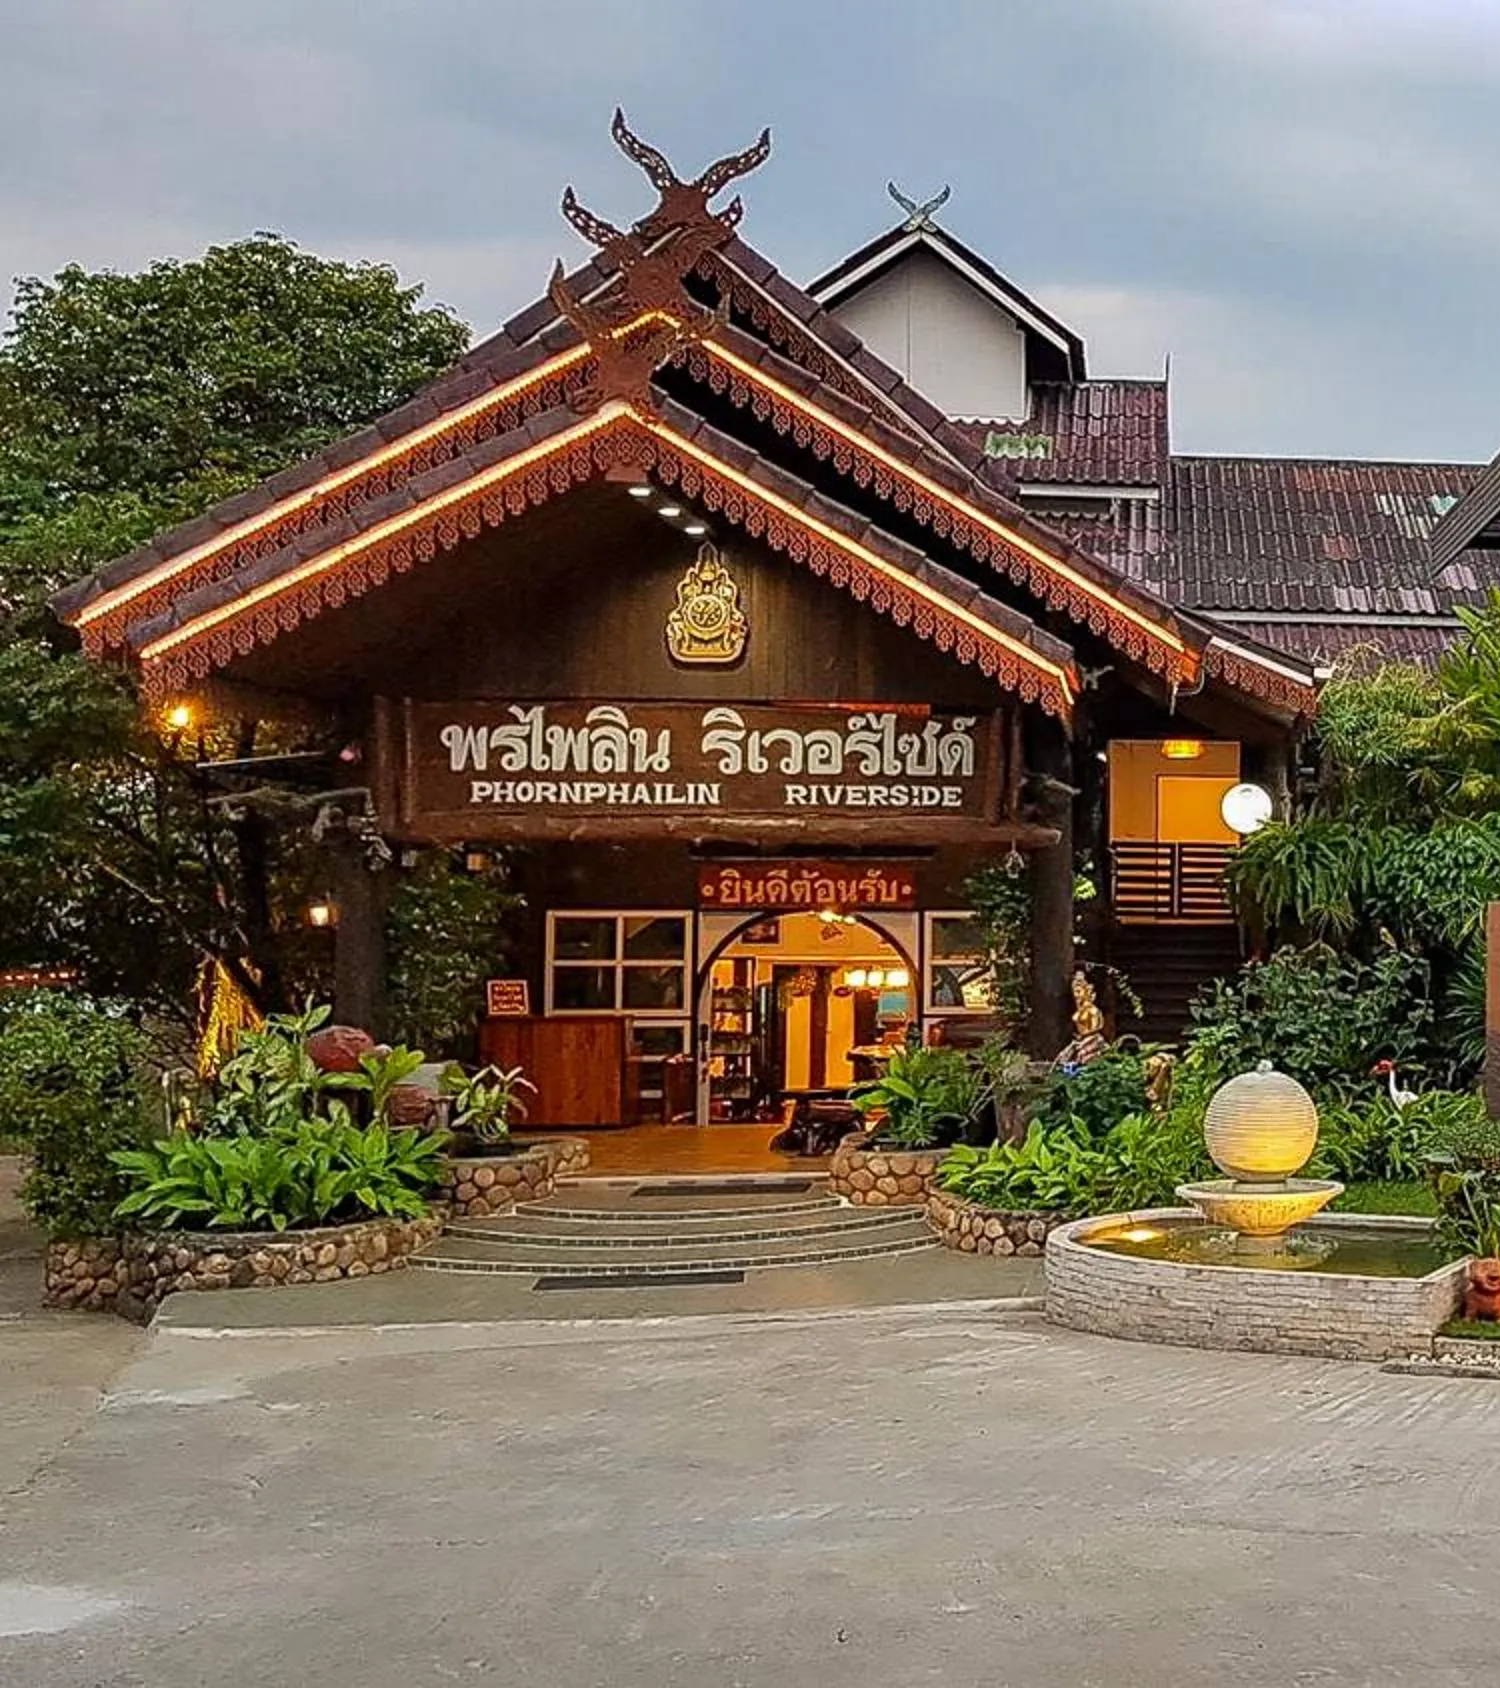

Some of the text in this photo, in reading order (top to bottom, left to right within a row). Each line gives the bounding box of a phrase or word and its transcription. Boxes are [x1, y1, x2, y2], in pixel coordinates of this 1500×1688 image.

[440, 705, 976, 777] พรไพลิน ริเวอร์ไซด์
[469, 781, 963, 807] PHORNPHAILIN RIVERSIDE
[719, 868, 898, 903] ยินดีต้อนรับ
